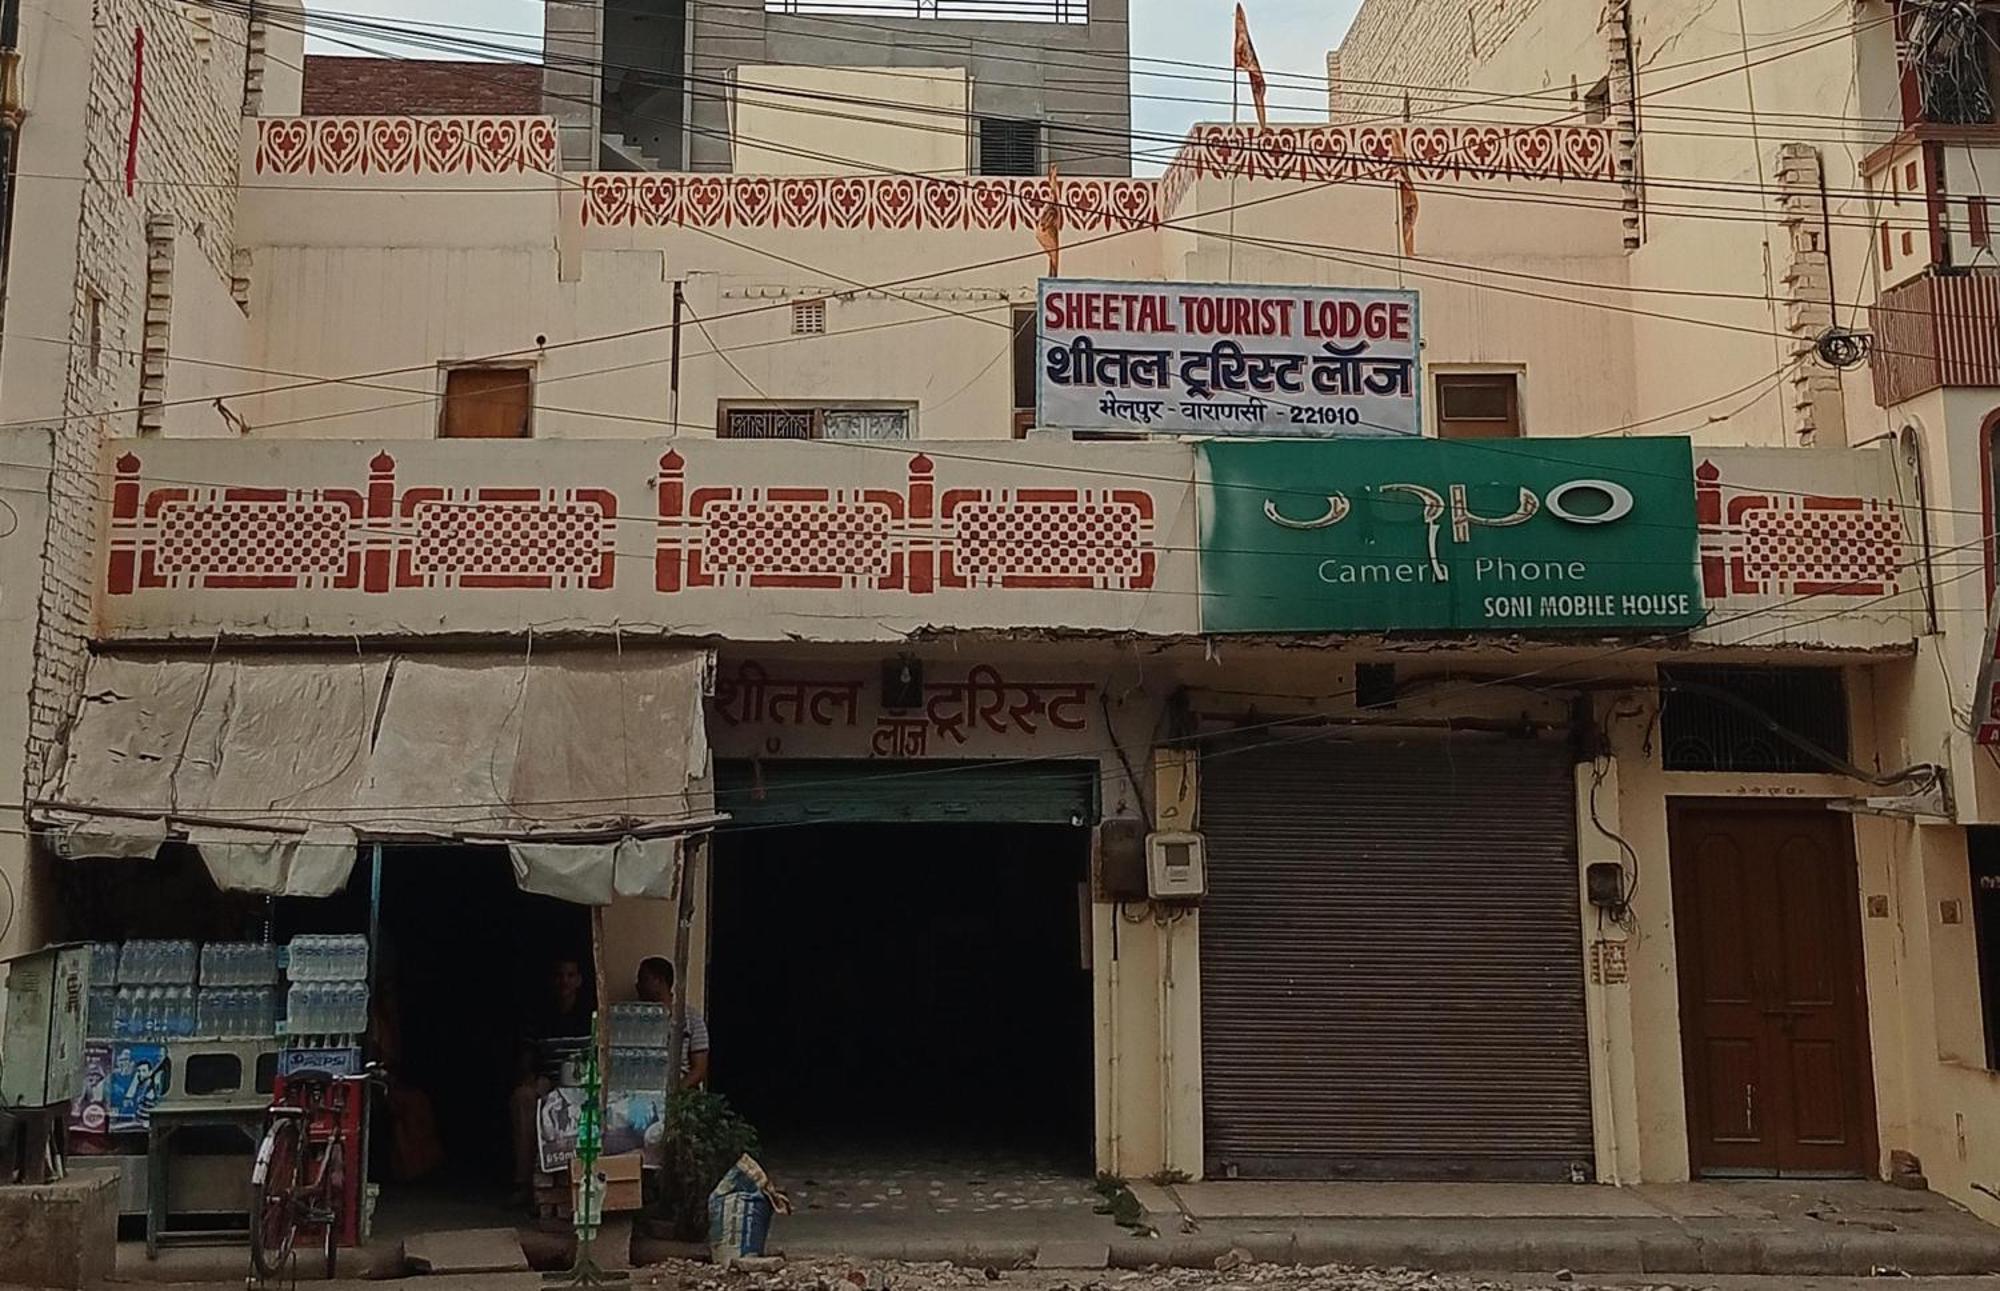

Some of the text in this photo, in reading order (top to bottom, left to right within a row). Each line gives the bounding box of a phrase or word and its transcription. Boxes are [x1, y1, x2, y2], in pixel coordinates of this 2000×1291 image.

[1045, 292, 1410, 339] SHEETAL TOURIST LODGE
[1046, 336, 1173, 388] शीतल
[1312, 340, 1413, 396] लॉज
[1099, 391, 1163, 423] भेलूपुर
[1180, 396, 1267, 423] वाराणसी
[1290, 406, 1359, 425] 221010
[1476, 557, 1587, 581] Phone
[1484, 594, 1689, 618] SONI MOBILE HOUSE
